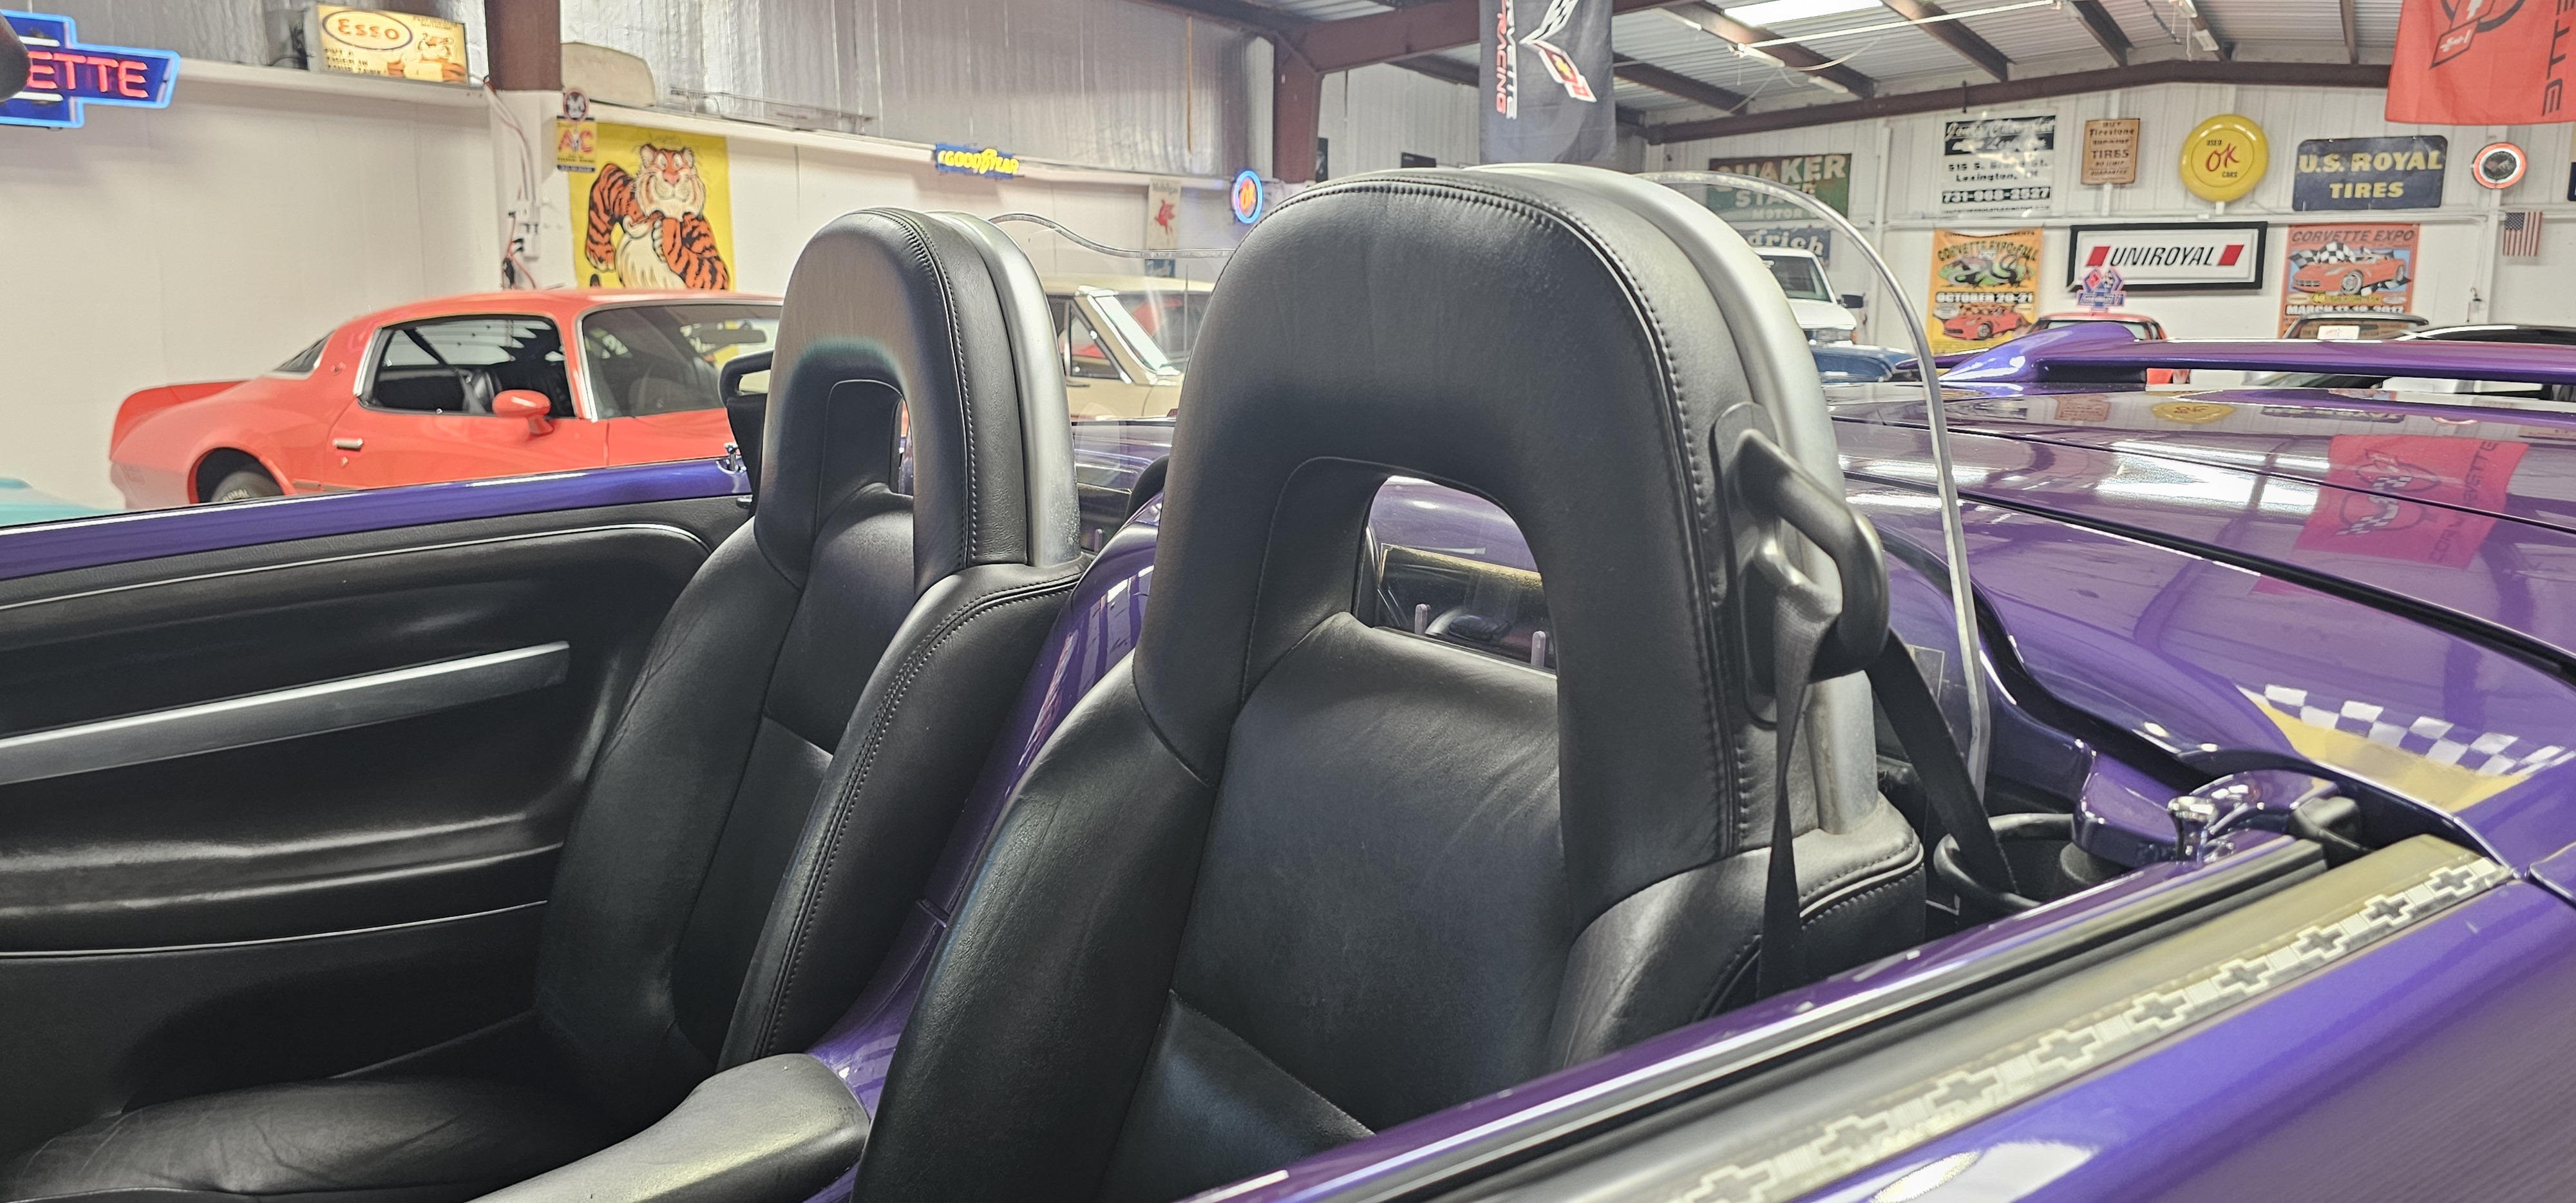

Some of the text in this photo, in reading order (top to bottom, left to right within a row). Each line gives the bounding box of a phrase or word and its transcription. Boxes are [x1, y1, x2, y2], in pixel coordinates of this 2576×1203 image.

[1497, 0, 1507, 115] RACING
[2091, 149, 2129, 159] TIRES
[2206, 143, 2239, 172] OK
[2299, 150, 2443, 173] U.S. ROYAL
[2329, 181, 2404, 199] TIRES
[2291, 229, 2415, 243] CORVETTE EXPO
[2110, 246, 2214, 267] UNIROYAL
[1936, 292, 1995, 303] OCTOBER
